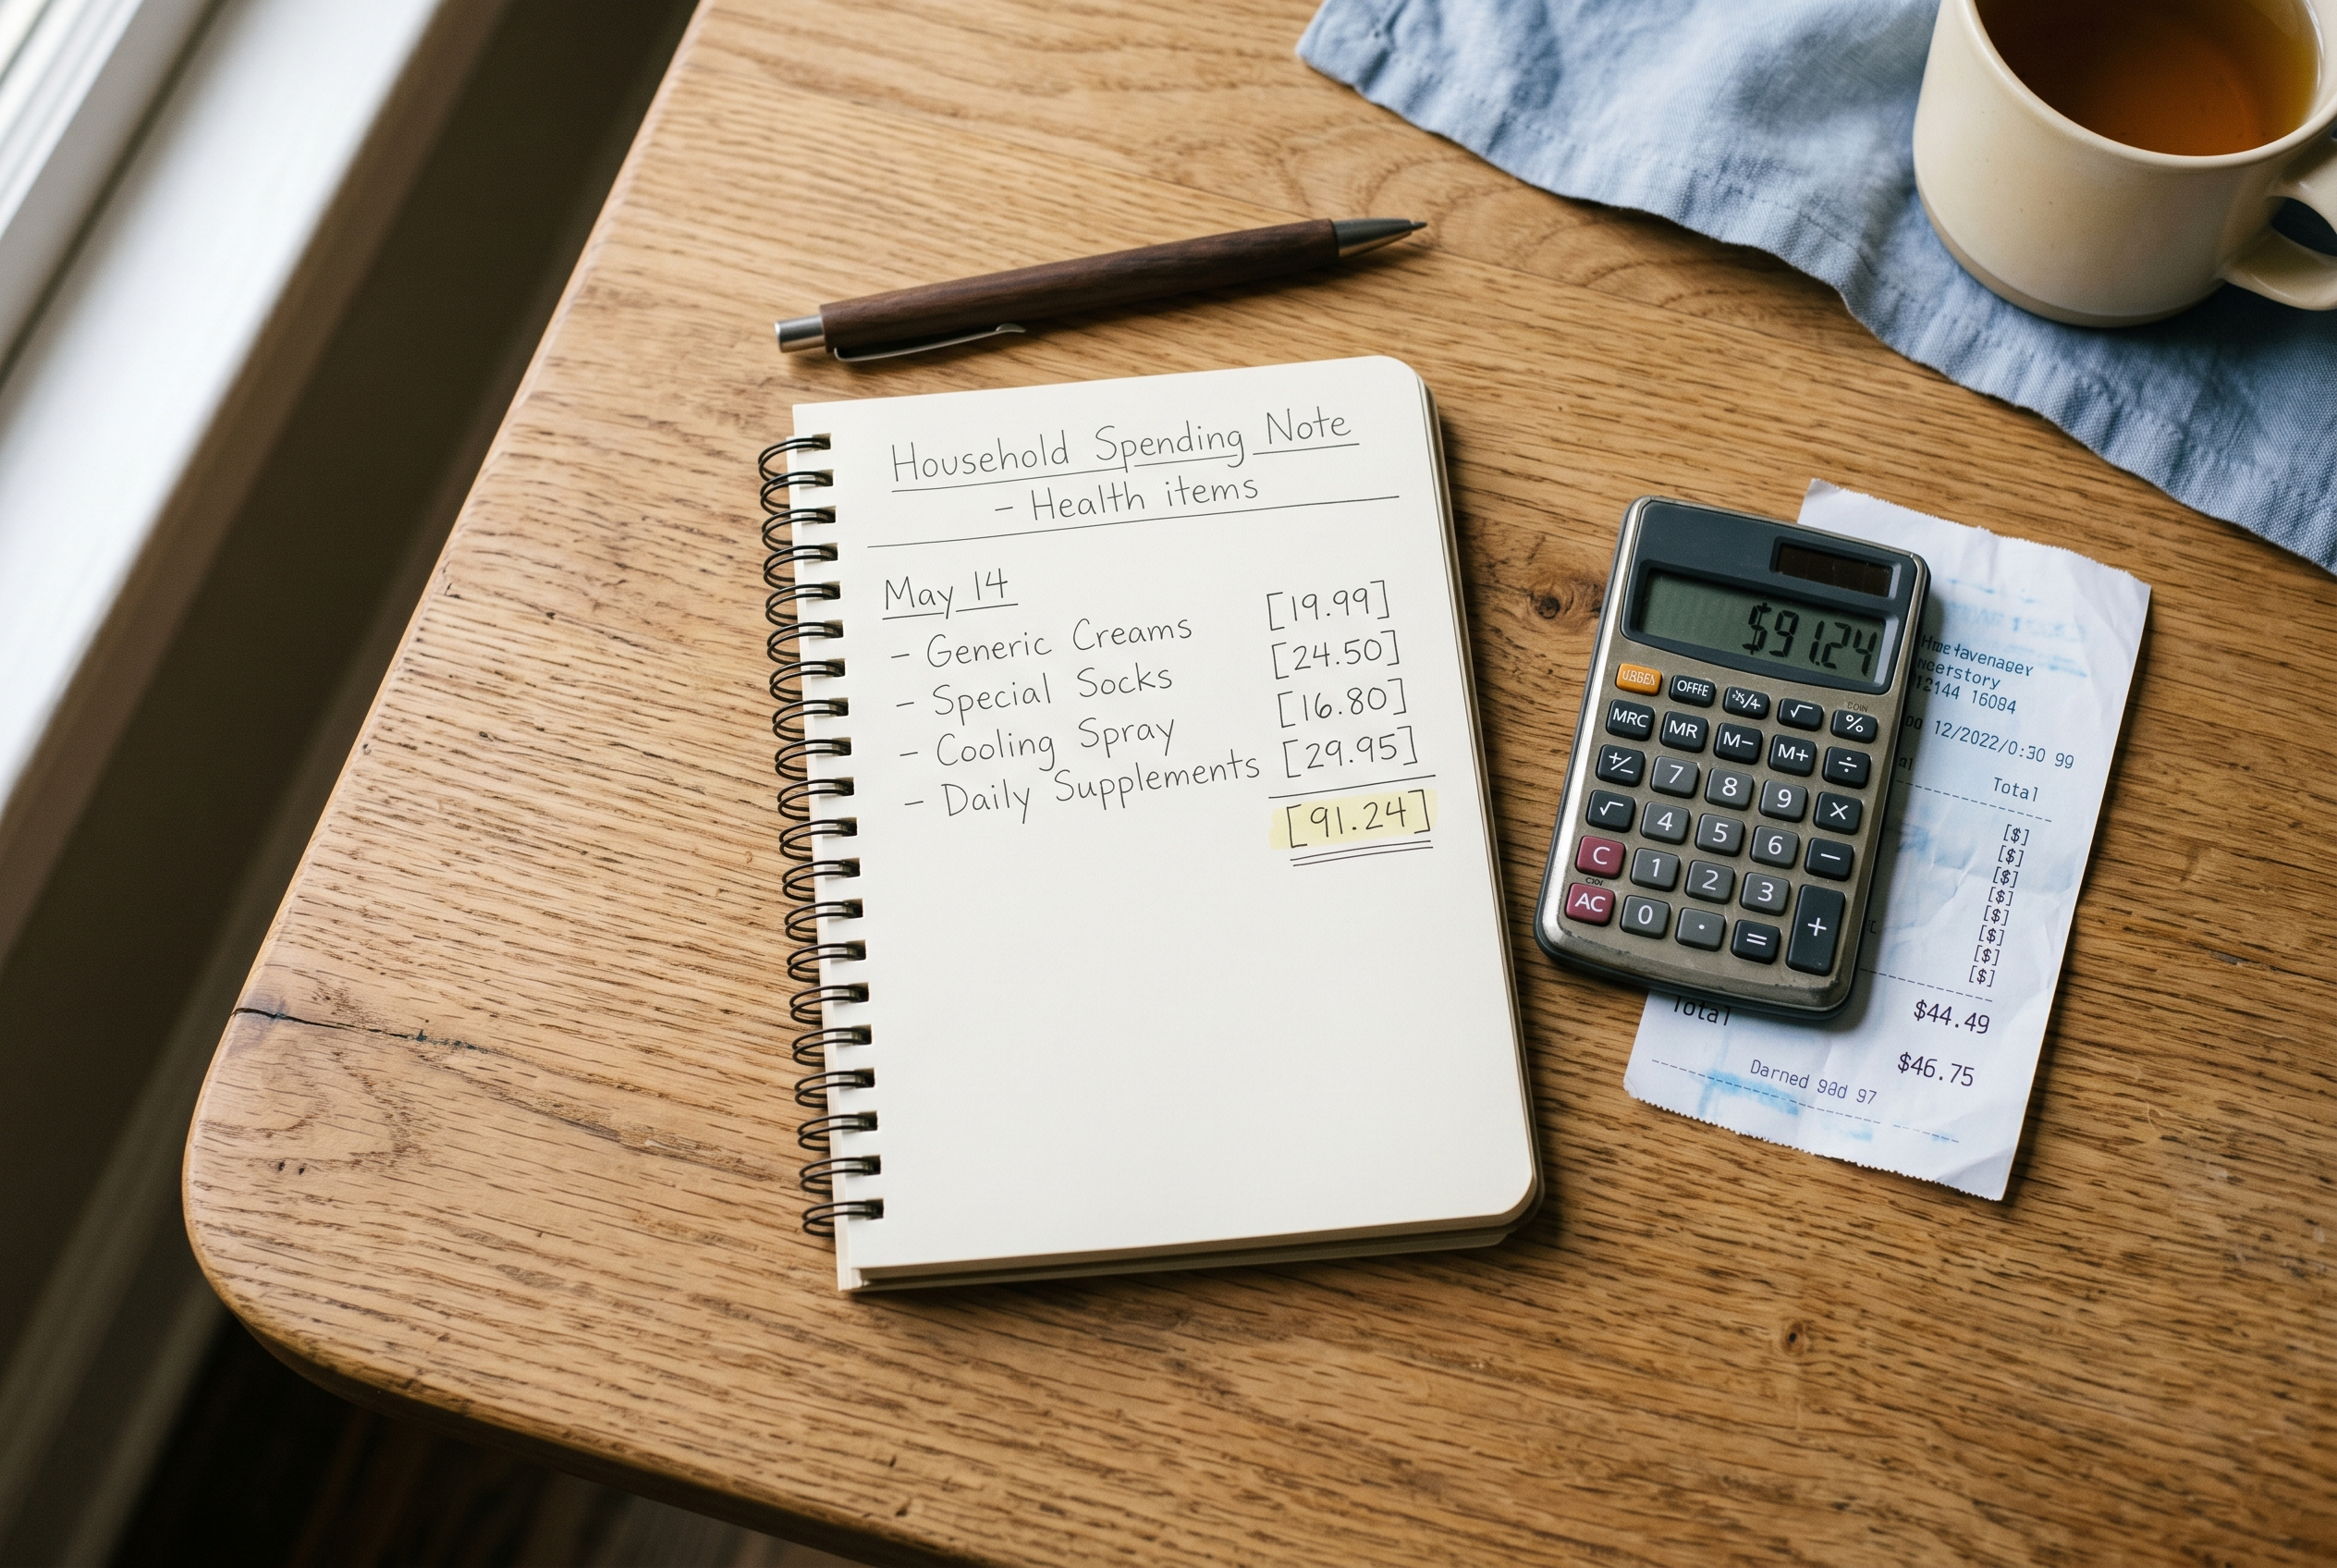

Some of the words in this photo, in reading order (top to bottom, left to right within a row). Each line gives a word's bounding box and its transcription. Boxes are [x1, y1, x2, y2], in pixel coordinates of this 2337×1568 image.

[891, 430, 1070, 483] Household
[1095, 420, 1245, 473] Spending
[1266, 405, 1352, 445] Note
[1031, 481, 1145, 521] Health
[1165, 474, 1258, 507] items
[885, 575, 954, 620] May
[974, 568, 1009, 601] 14
[926, 632, 1053, 668] Generic
[1072, 618, 1193, 651] Creams
[1266, 579, 1390, 631] [19.99]
[1742, 602, 1878, 677] $91.24
[932, 673, 1051, 727] Special
[1076, 663, 1173, 698] Socks
[1270, 629, 1401, 680] [24.50]
[1972, 690, 2017, 715] 16084
[936, 728, 1056, 772] Cooling
[1078, 717, 1175, 759] Spray
[1277, 677, 1407, 729] [16.80]
[1613, 708, 1649, 729] MRC
[1669, 719, 1698, 739] MR
[1778, 743, 1809, 762] M+
[940, 779, 1031, 825] Daily
[1054, 749, 1260, 811] Supplements
[1281, 725, 1418, 779] [29.95]
[1670, 765, 1684, 784] 7
[1721, 777, 1738, 797] 8
[1993, 777, 2038, 802] Total
[1777, 789, 1793, 809] 9
[1286, 789, 1431, 850] [91.24]
[1657, 812, 1673, 831] 4
[1712, 823, 1727, 843] 5
[1593, 846, 1609, 865] C
[1768, 835, 1782, 855] 6
[1652, 858, 1661, 877] 1
[1702, 869, 1719, 890] 2
[1574, 892, 1607, 913] AC
[1757, 882, 1774, 902] 3
[1638, 904, 1653, 925] 0
[1913, 998, 1990, 1035] $44.49
[1897, 1051, 1975, 1087] $46.75
[1750, 1059, 1810, 1089] Darned
[1856, 1088, 1878, 1105] 97
